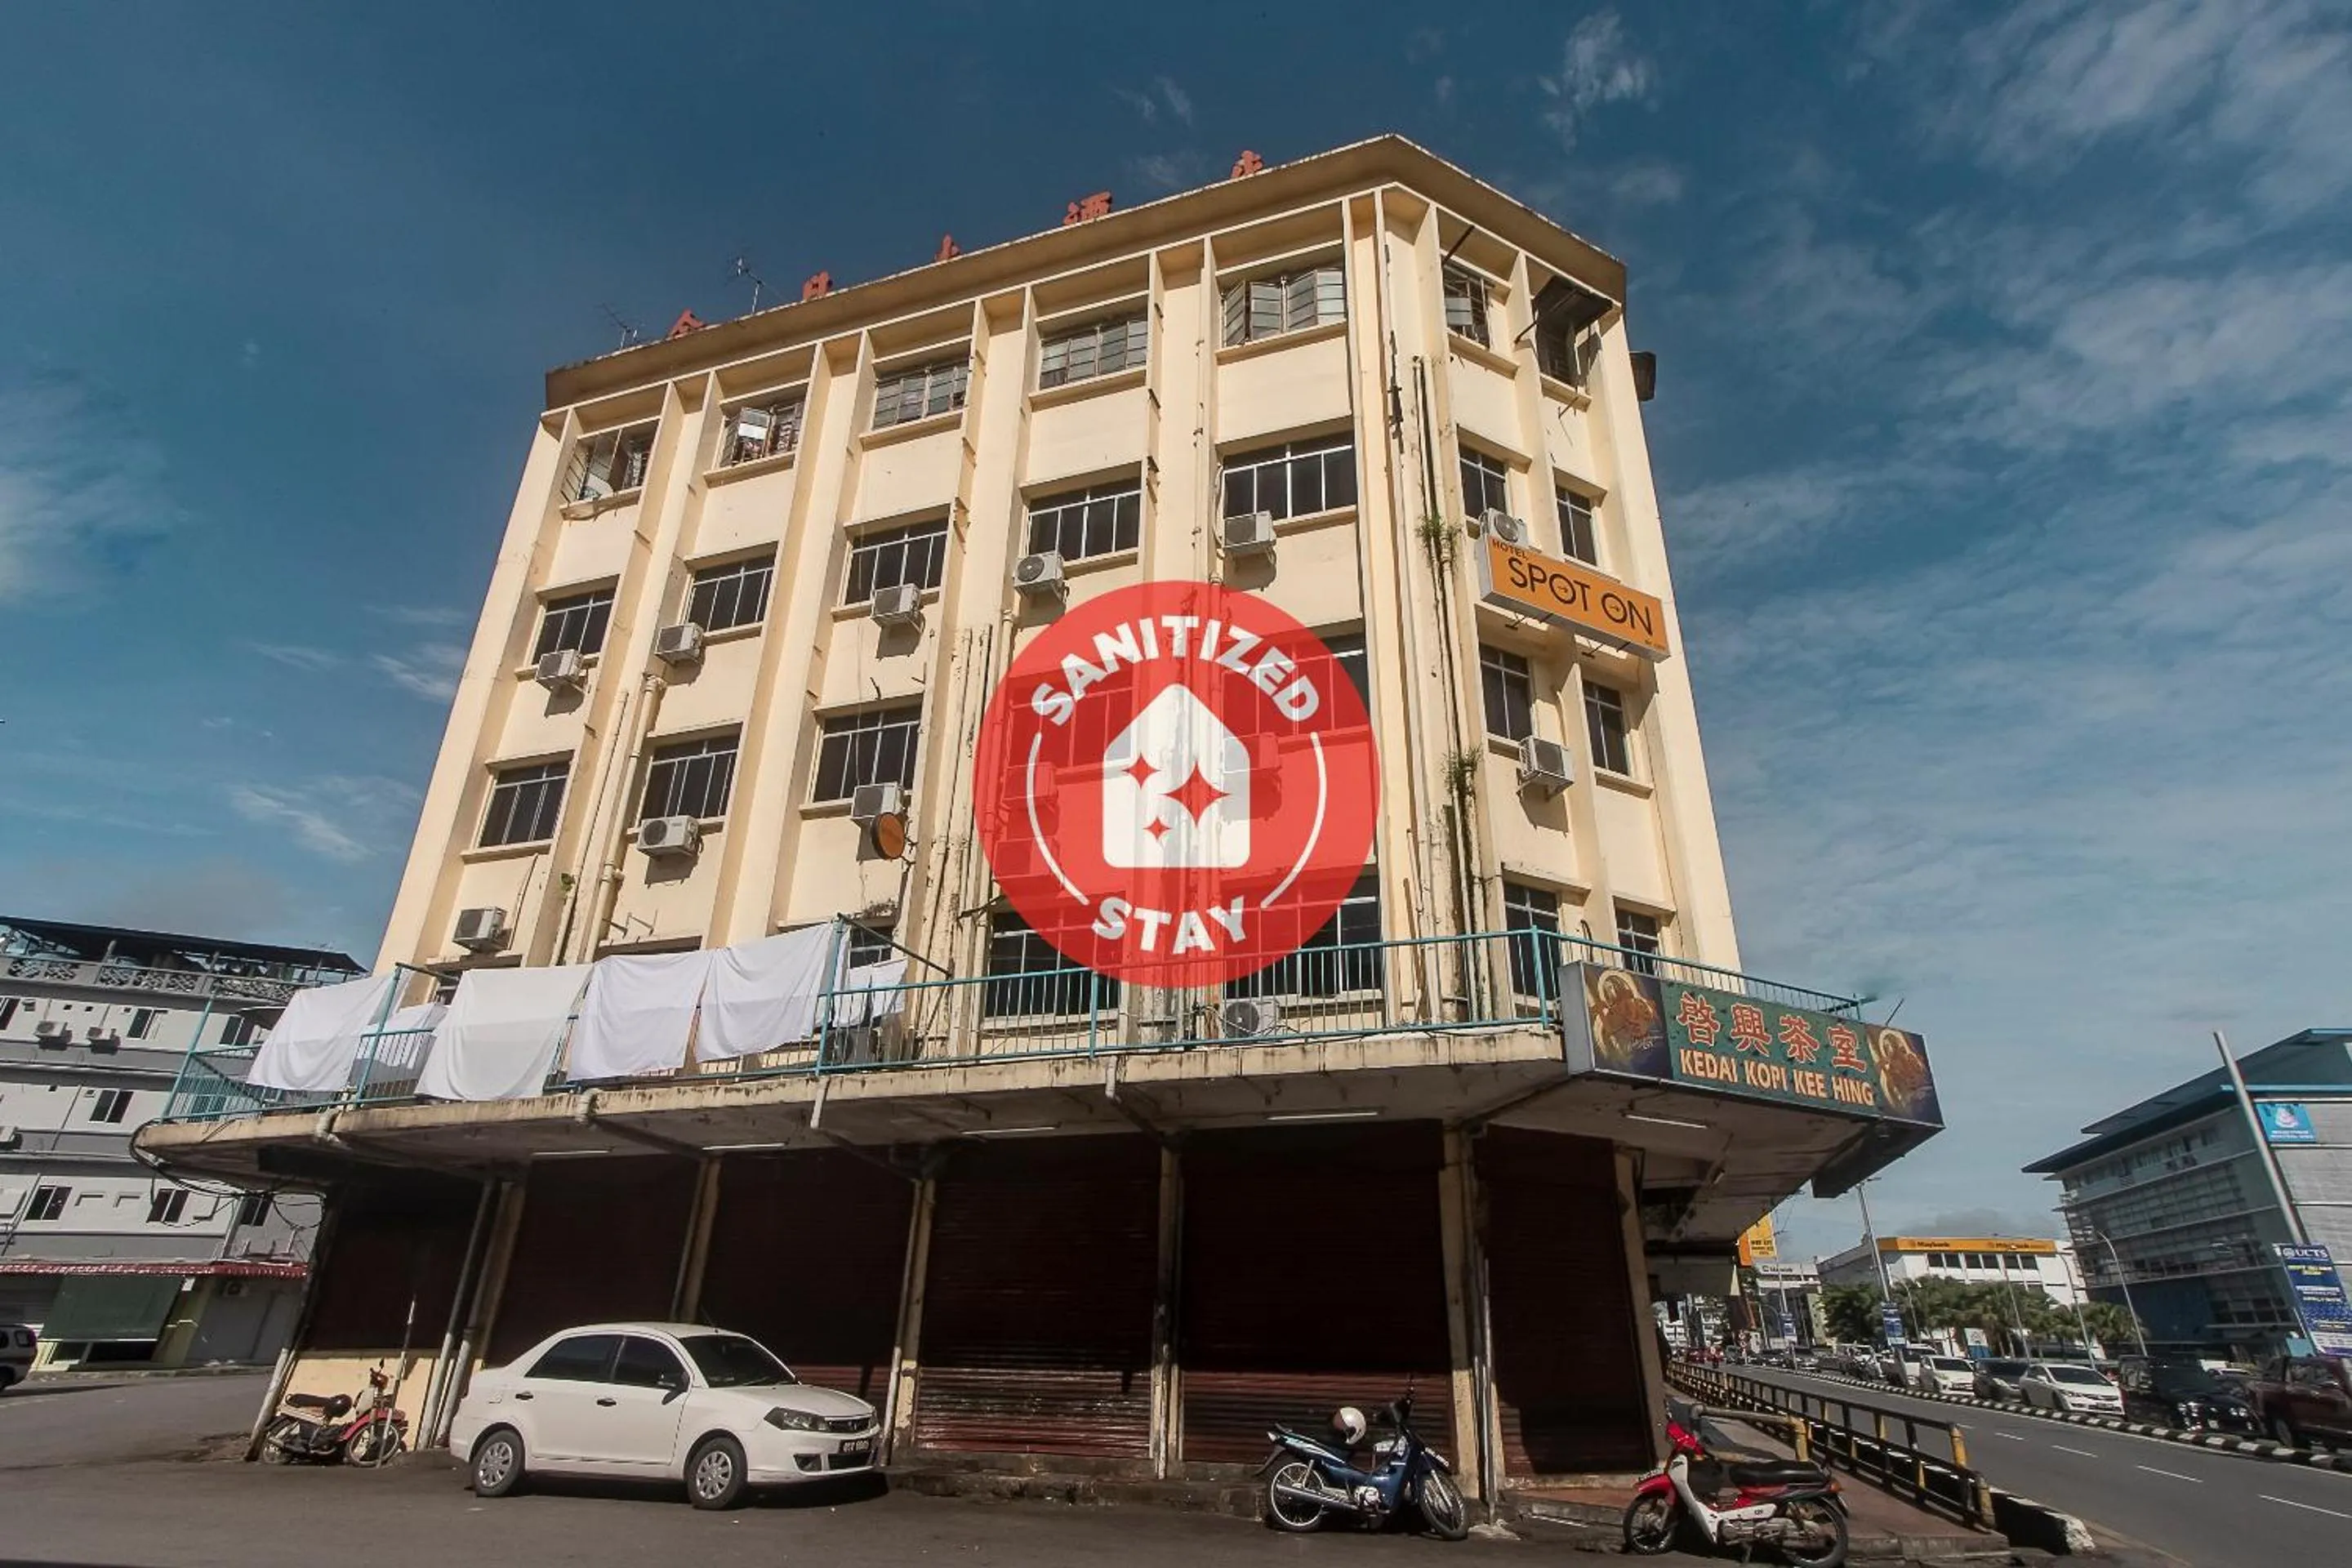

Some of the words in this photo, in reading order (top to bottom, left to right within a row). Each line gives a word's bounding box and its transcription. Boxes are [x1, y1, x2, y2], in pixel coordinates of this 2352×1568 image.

[1492, 538, 1527, 559] HOTEL
[1508, 556, 1591, 612] SPOT
[1601, 592, 1654, 636] ON
[1679, 1048, 1738, 1083] KEDAI
[1744, 1062, 1788, 1093] KOPI
[1793, 1071, 1828, 1098] KEE
[1832, 1076, 1875, 1107] HING
